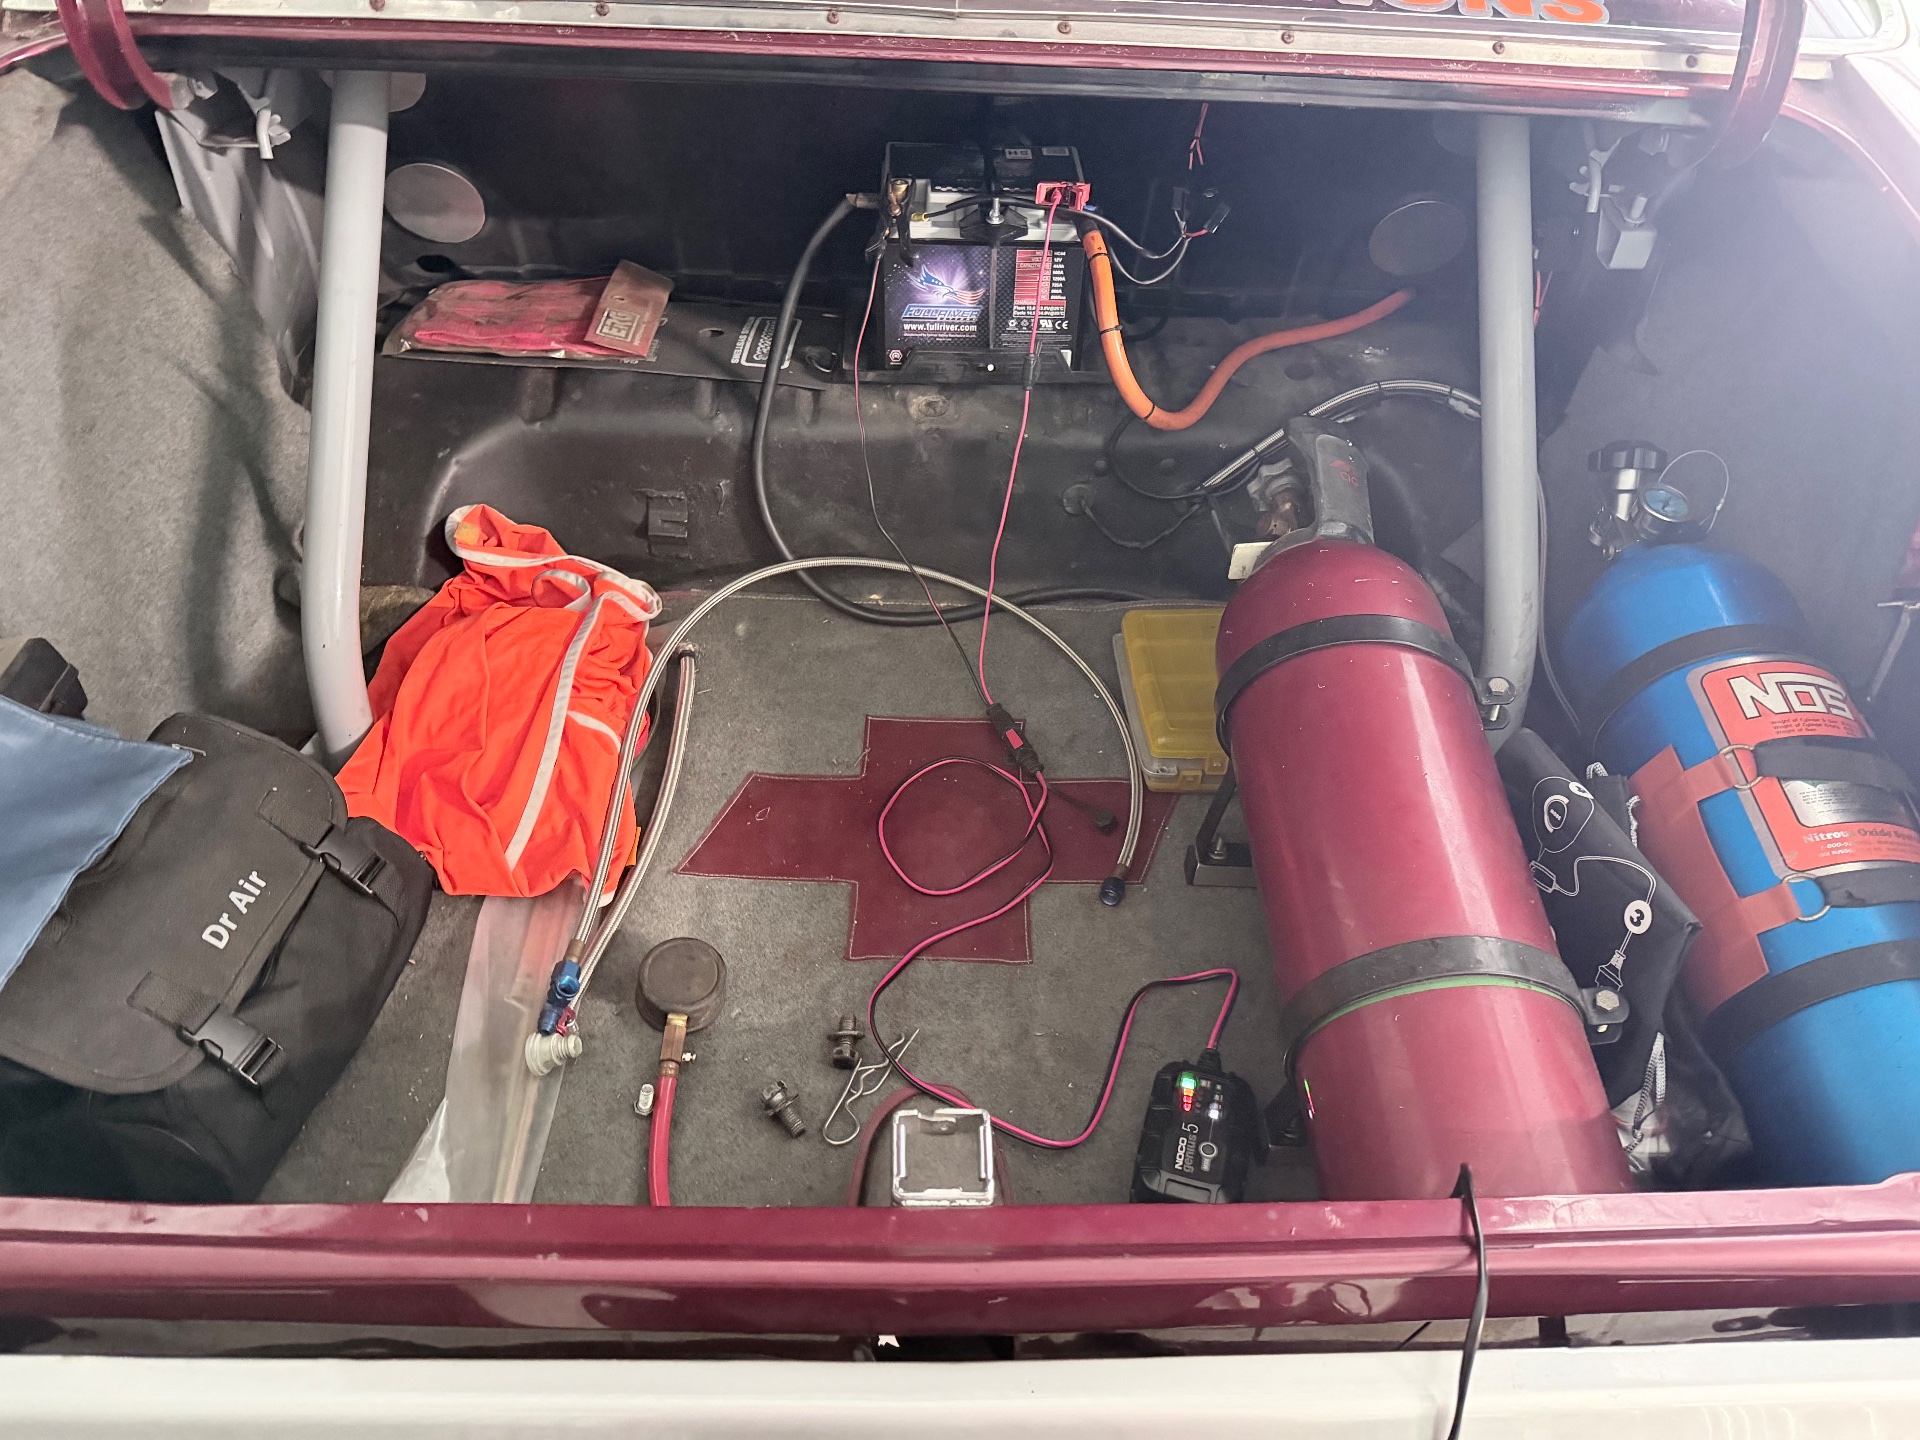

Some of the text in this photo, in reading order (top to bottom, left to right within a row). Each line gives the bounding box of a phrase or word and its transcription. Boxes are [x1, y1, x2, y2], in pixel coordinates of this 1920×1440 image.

[901, 304, 983, 320] FULLRIVER
[903, 323, 977, 332] www.fullriver.com
[1727, 671, 1855, 721] NOS
[202, 870, 267, 950] Dr Air
[1629, 908, 1645, 927] 3
[1181, 1122, 1199, 1134] 5
[1174, 1136, 1188, 1170] NOCO
[1182, 1134, 1197, 1174] genius
